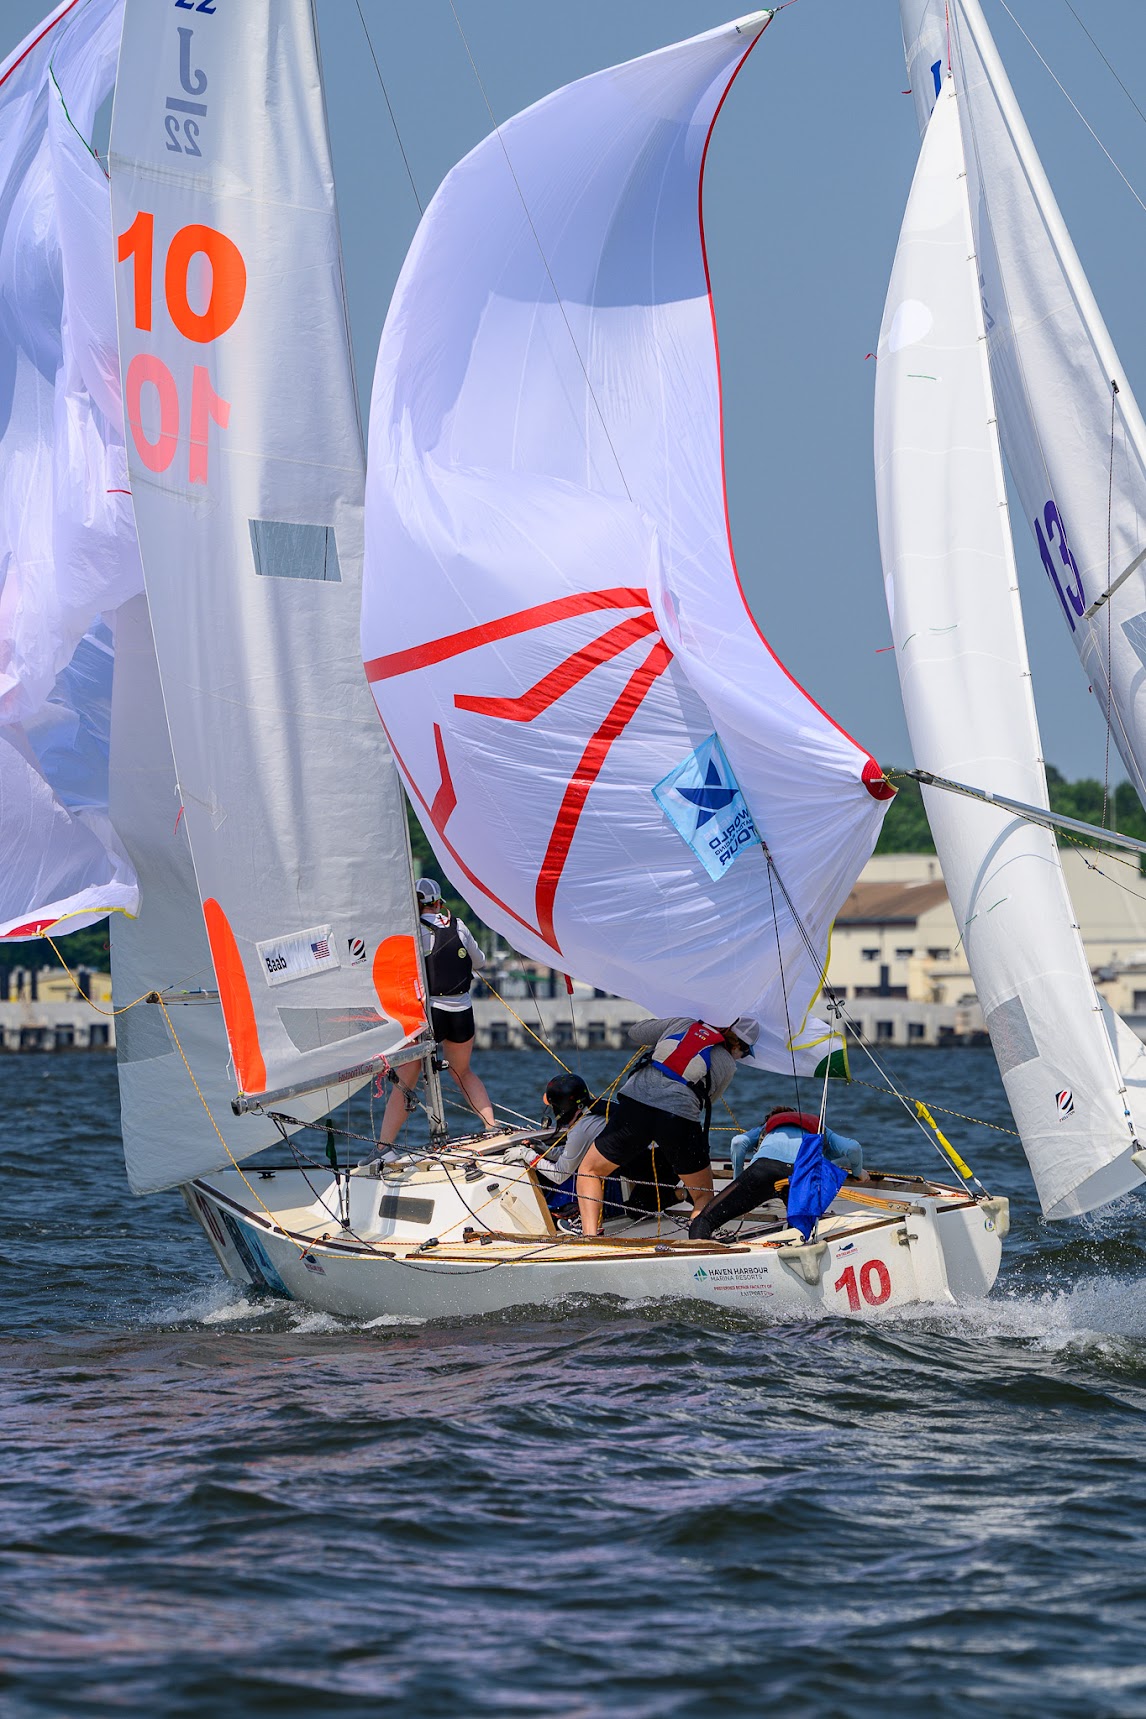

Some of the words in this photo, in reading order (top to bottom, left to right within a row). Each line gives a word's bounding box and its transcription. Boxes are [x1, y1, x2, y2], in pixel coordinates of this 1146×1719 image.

[117, 210, 247, 344] 10
[1033, 500, 1086, 632] 13
[265, 954, 287, 973] Baab
[708, 1268, 733, 1276] HAVEN
[733, 1267, 769, 1275] HARBOUR
[834, 1259, 891, 1313] 10
